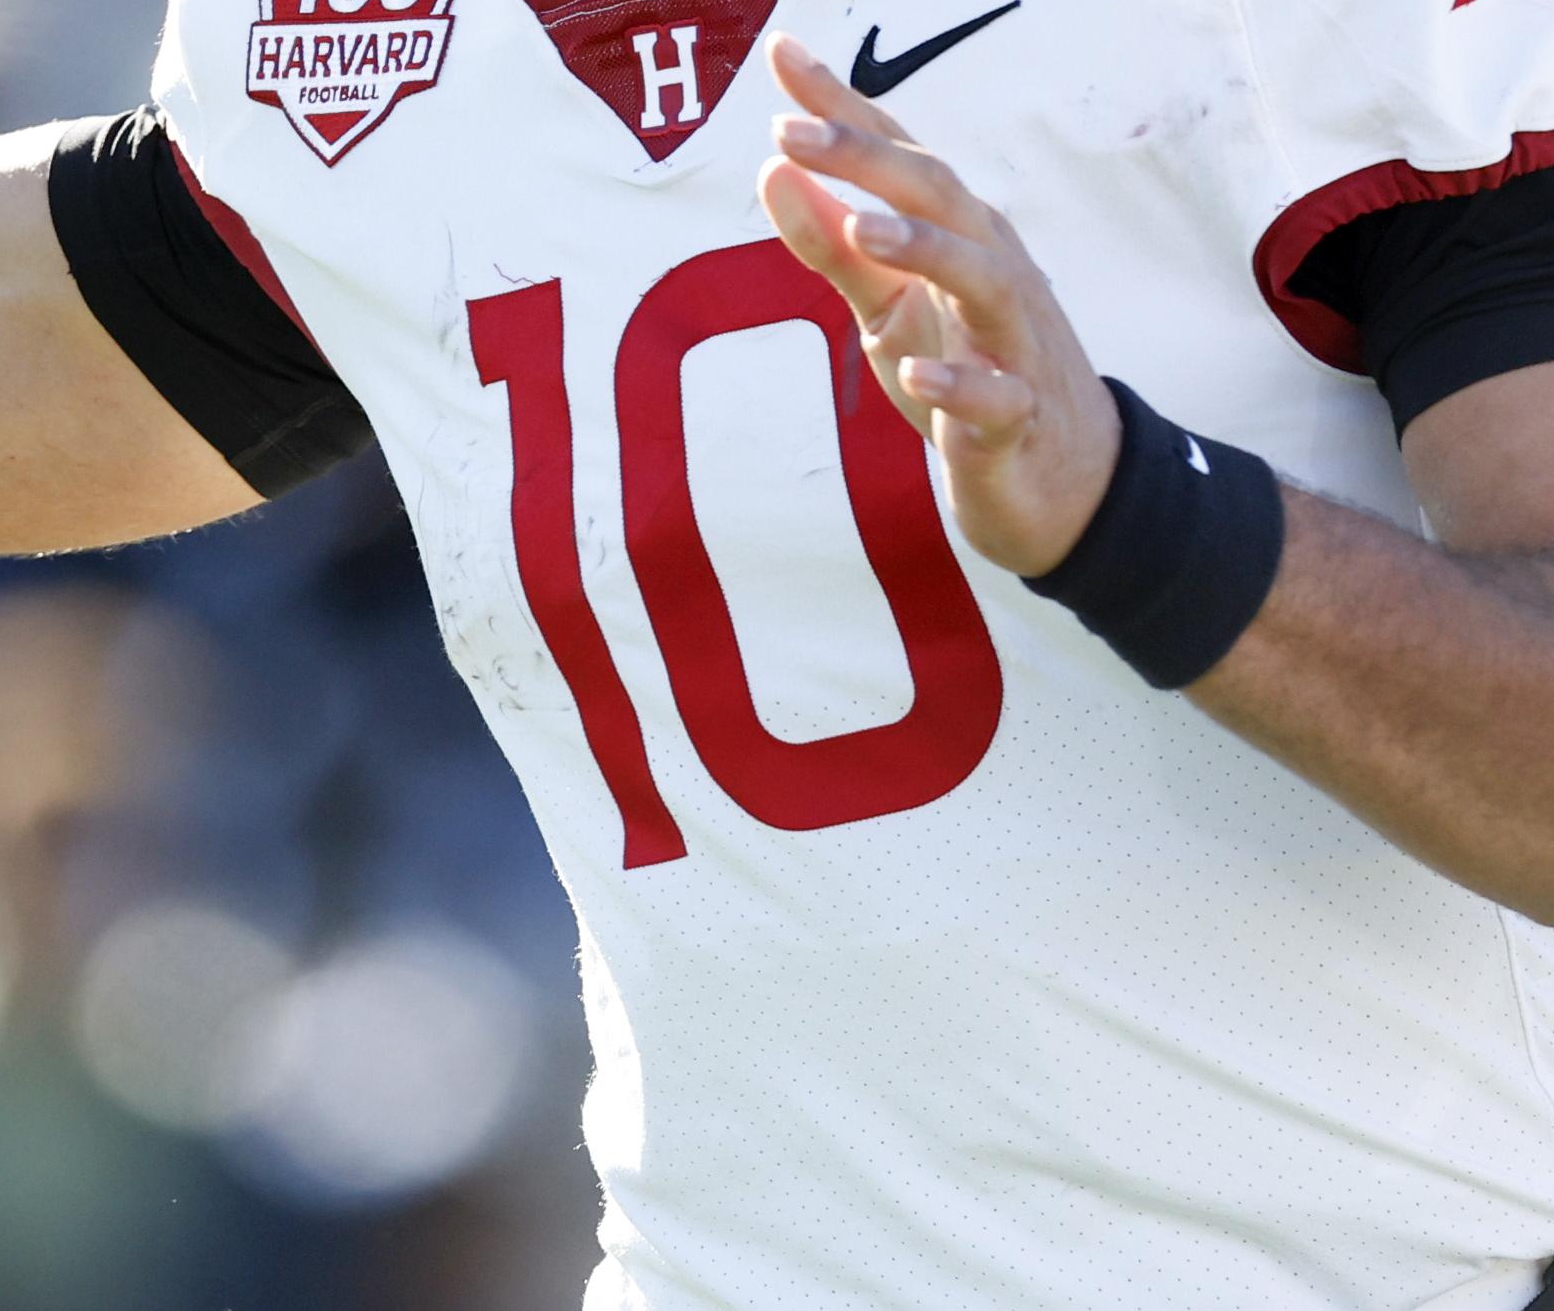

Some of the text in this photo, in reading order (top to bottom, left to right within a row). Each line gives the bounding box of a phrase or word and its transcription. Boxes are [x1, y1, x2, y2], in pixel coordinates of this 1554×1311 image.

[255, 29, 435, 80] HARVARD
[631, 24, 704, 130] H
[297, 83, 381, 105] FOOTBALL
[464, 235, 1005, 871] 10
